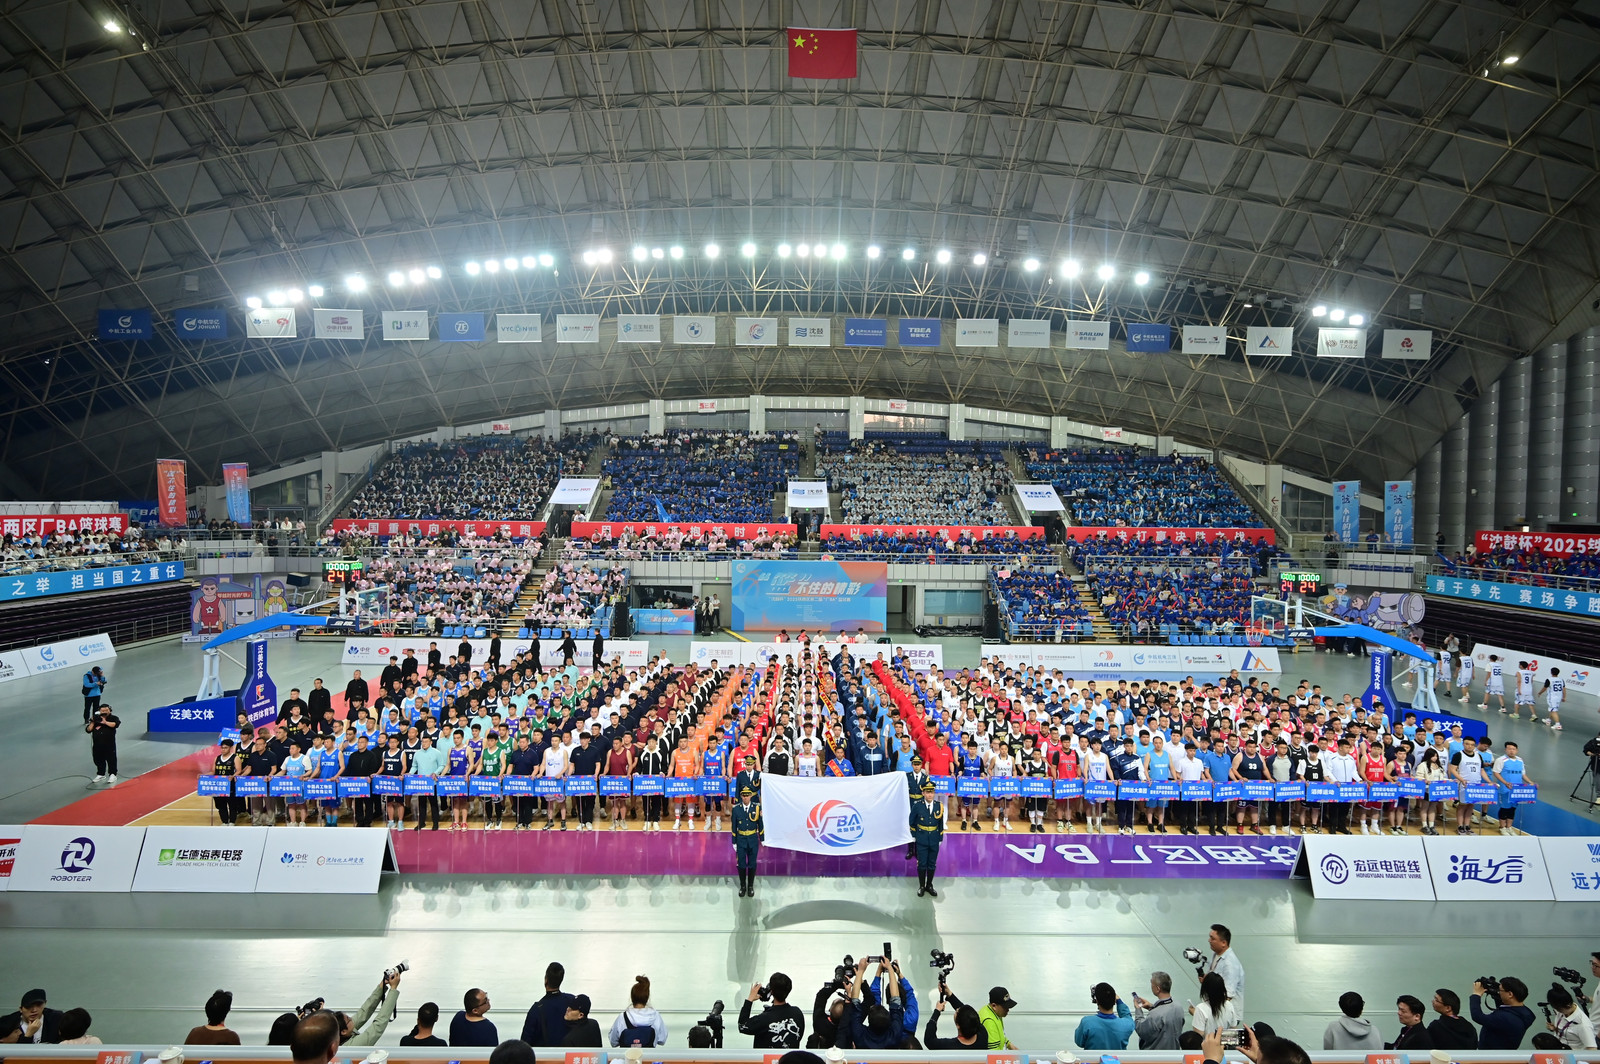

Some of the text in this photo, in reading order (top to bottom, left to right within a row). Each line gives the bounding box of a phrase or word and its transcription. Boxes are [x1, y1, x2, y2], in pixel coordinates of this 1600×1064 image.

[0, 516, 122, 537] 西区厂BA篮球赛
[327, 570, 361, 582] 24 24
[1281, 580, 1315, 593] 24 24
[1524, 676, 1529, 684] 9
[1553, 683, 1563, 692] 63
[170, 709, 214, 720] 泛美文体
[178, 849, 243, 861] 华德海泰电器
[1353, 859, 1421, 873] 宏远电磁线
